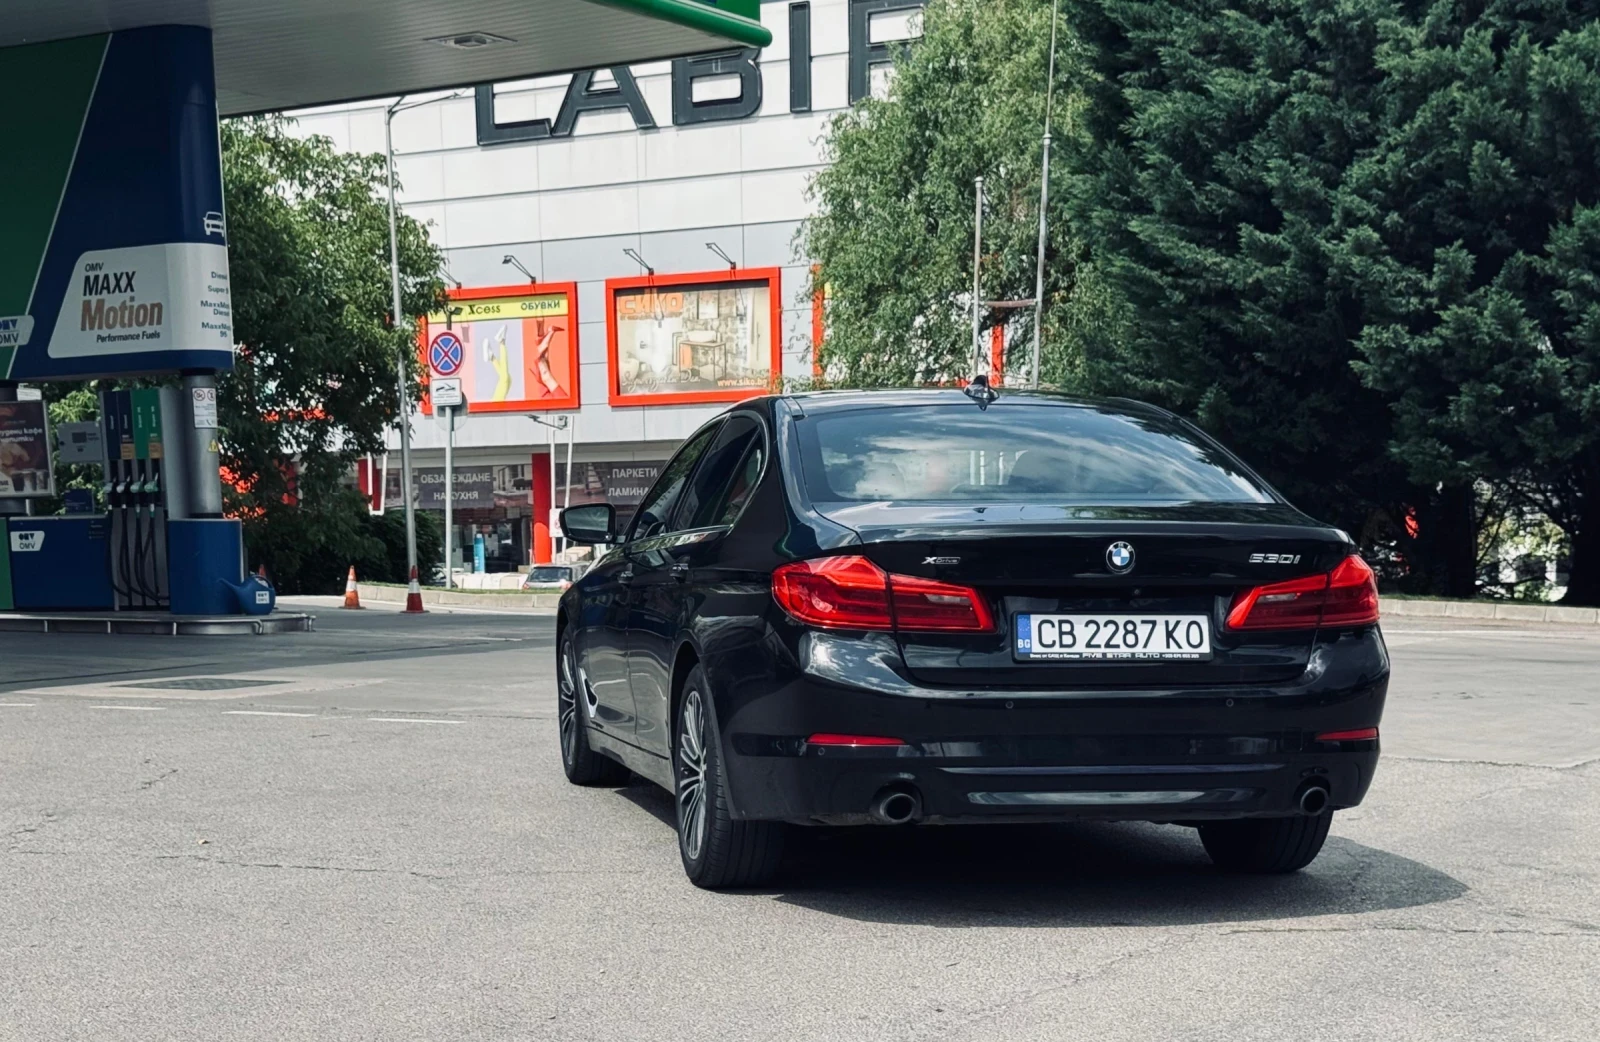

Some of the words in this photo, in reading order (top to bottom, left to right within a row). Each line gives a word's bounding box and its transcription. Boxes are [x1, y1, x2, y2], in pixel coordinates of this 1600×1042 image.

[84, 262, 104, 273] OMV
[83, 271, 136, 297] MAXX
[80, 295, 163, 331] Motion
[468, 304, 501, 315] Xcess
[520, 300, 561, 311] ОБУВКИ
[96, 333, 141, 344] Performance
[141, 330, 161, 340] Fuels
[717, 377, 768, 389] www.siko.bg
[420, 472, 491, 484] ОБЗАЕЖДАНЕ
[612, 467, 658, 478] ПАРКЕТИ
[1037, 619, 1077, 649] CB
[1084, 619, 1157, 649] 2287
[1164, 620, 1204, 650] KO
[1017, 639, 1031, 649] BG
